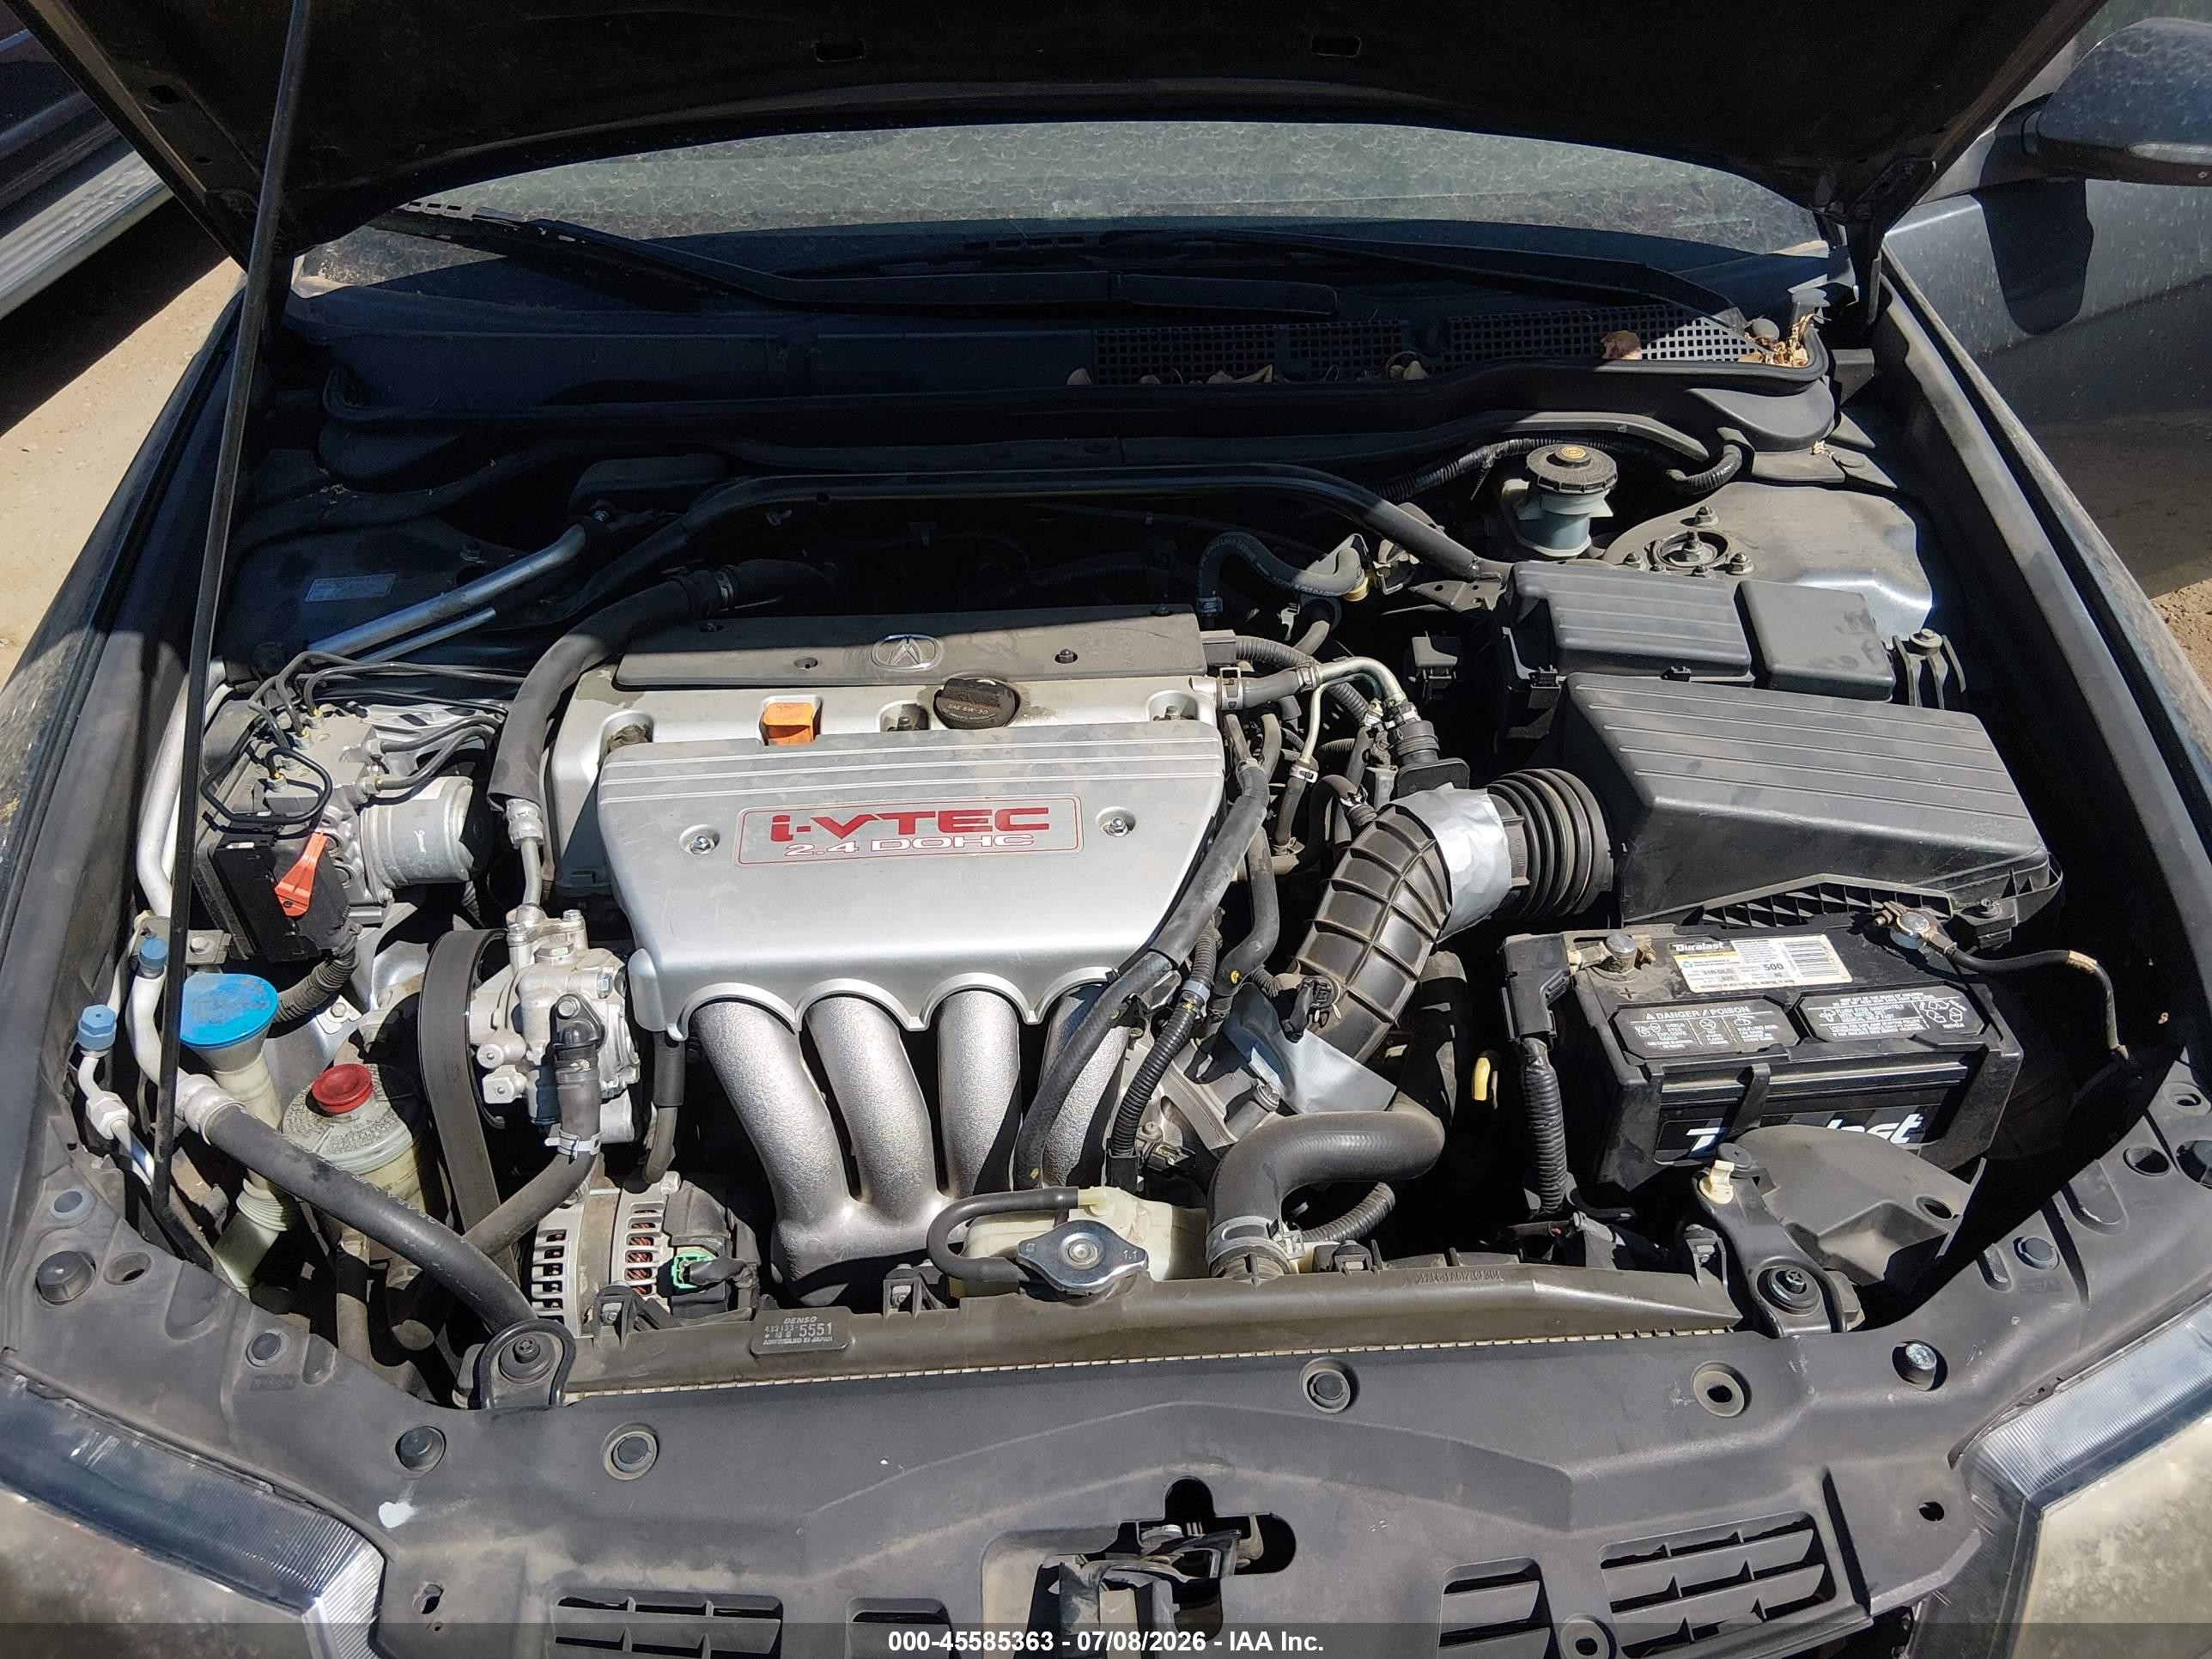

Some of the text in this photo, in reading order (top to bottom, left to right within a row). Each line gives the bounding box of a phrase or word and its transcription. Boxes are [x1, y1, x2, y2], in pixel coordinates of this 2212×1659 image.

[769, 807, 1049, 842] i-VTEC
[785, 834, 1035, 857] 2.4 DOHC
[1672, 941, 1725, 952] Duralast
[1763, 963, 1784, 971] 500
[1655, 1009, 1700, 1020] DANGER
[1710, 1006, 1751, 1017] POISON
[1122, 1249, 1139, 1261] 1.1
[783, 1316, 817, 1324] DENSO
